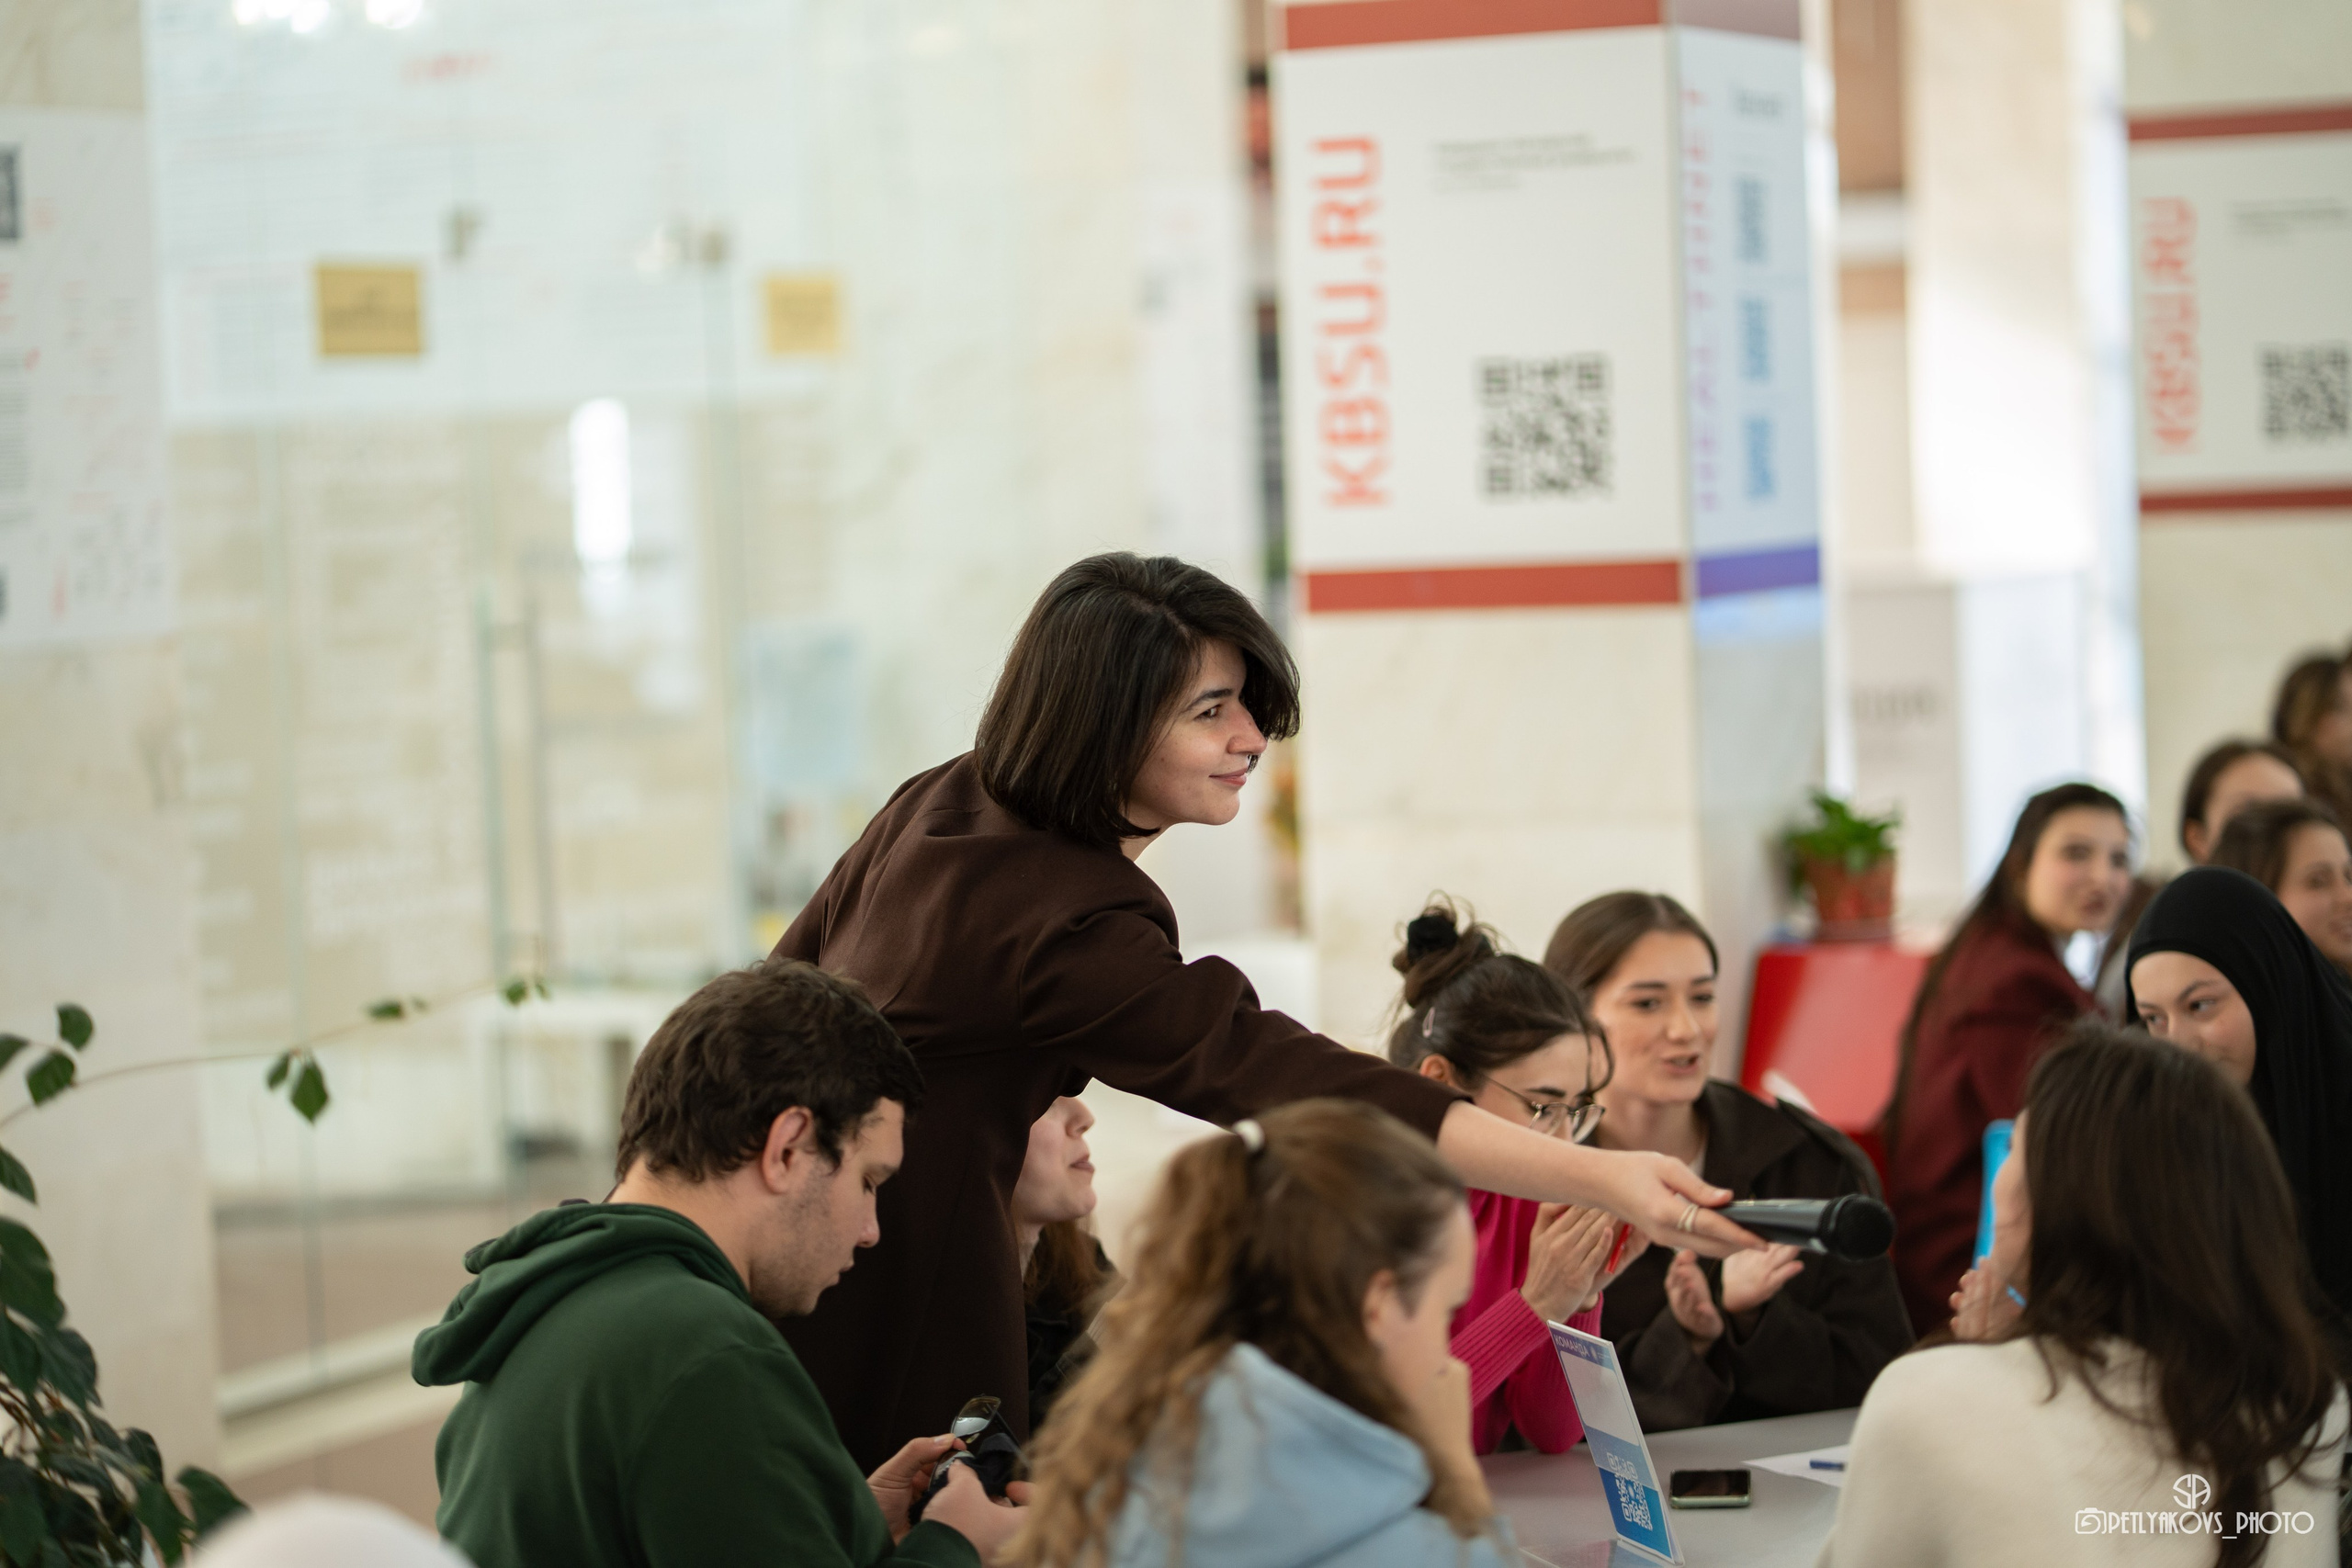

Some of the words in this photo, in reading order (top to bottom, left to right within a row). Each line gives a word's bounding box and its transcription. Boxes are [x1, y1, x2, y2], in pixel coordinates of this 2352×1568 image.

[1311, 134, 1390, 510] KBSU.RU
[2143, 197, 2199, 451] KBSURU
[1553, 1334, 1591, 1358] КОМАНДА
